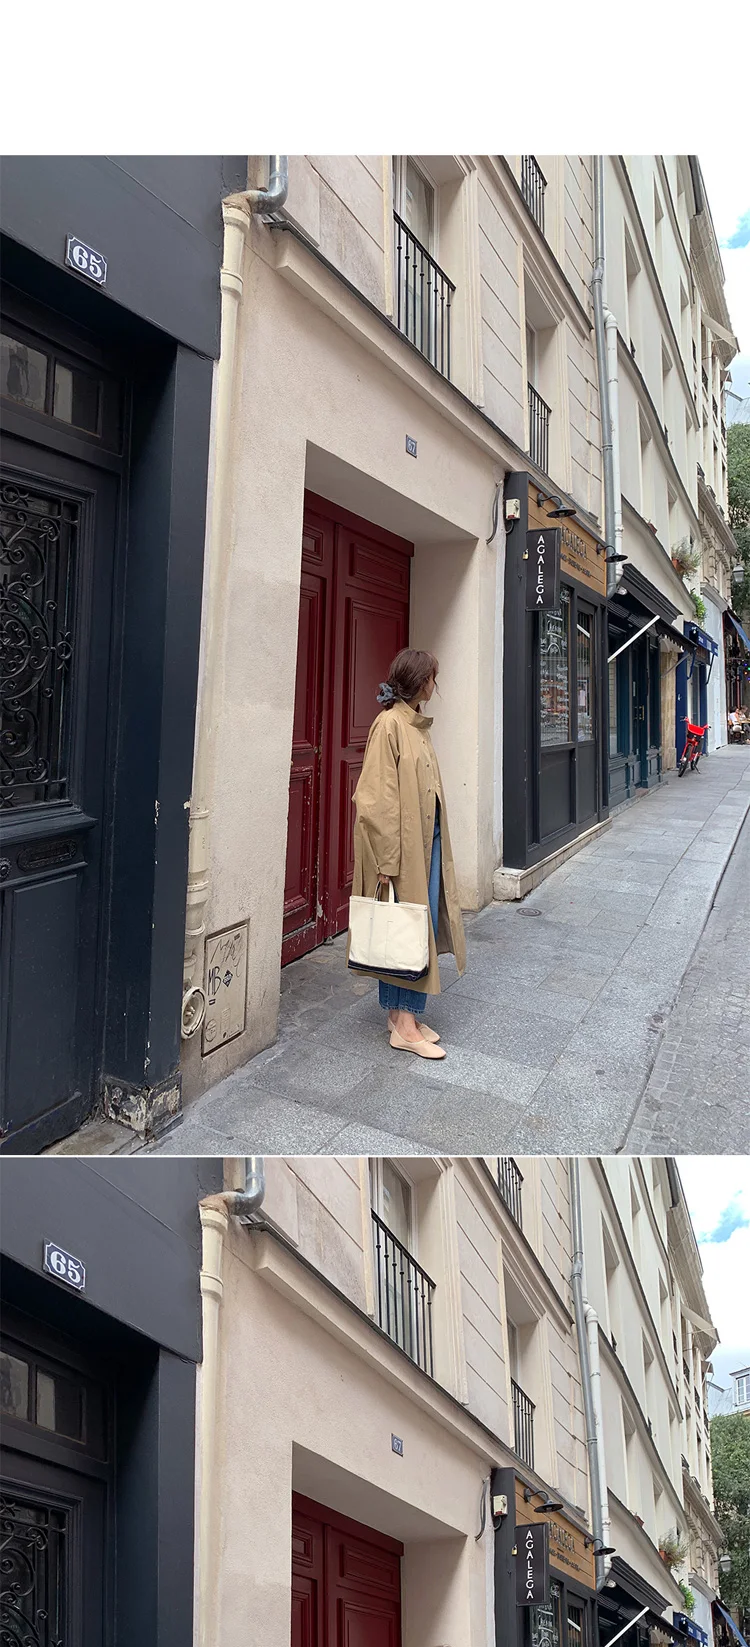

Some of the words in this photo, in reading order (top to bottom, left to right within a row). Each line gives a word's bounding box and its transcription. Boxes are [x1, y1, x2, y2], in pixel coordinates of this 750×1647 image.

[72, 245, 102, 278] 65
[535, 534, 546, 605] AGALEGA
[50, 1251, 81, 1283] 65
[525, 1530, 534, 1600] AGALEGA
